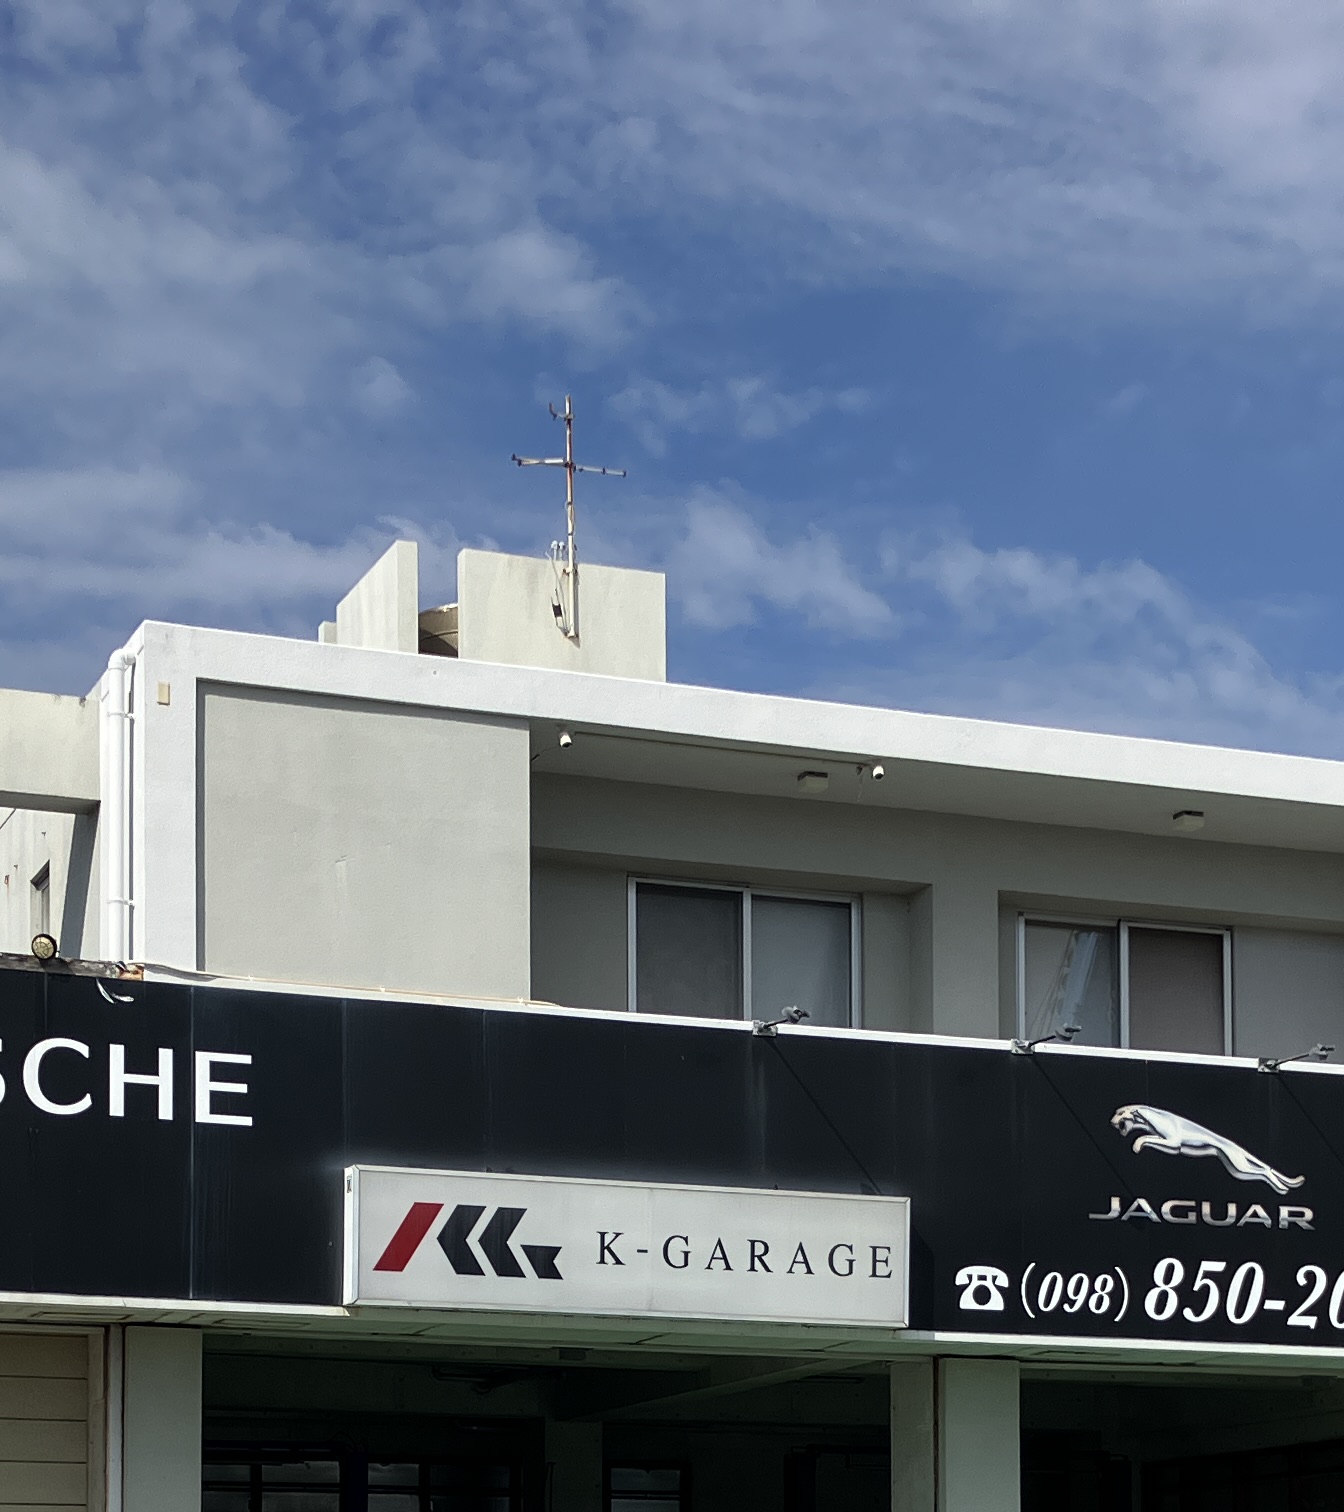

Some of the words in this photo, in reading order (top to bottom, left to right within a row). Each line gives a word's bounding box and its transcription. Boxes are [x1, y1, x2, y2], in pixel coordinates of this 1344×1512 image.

[1088, 1196, 1316, 1231] JAGUAR
[596, 1230, 894, 1280] K-GARAGE
[1020, 1262, 1130, 1322] (098)
